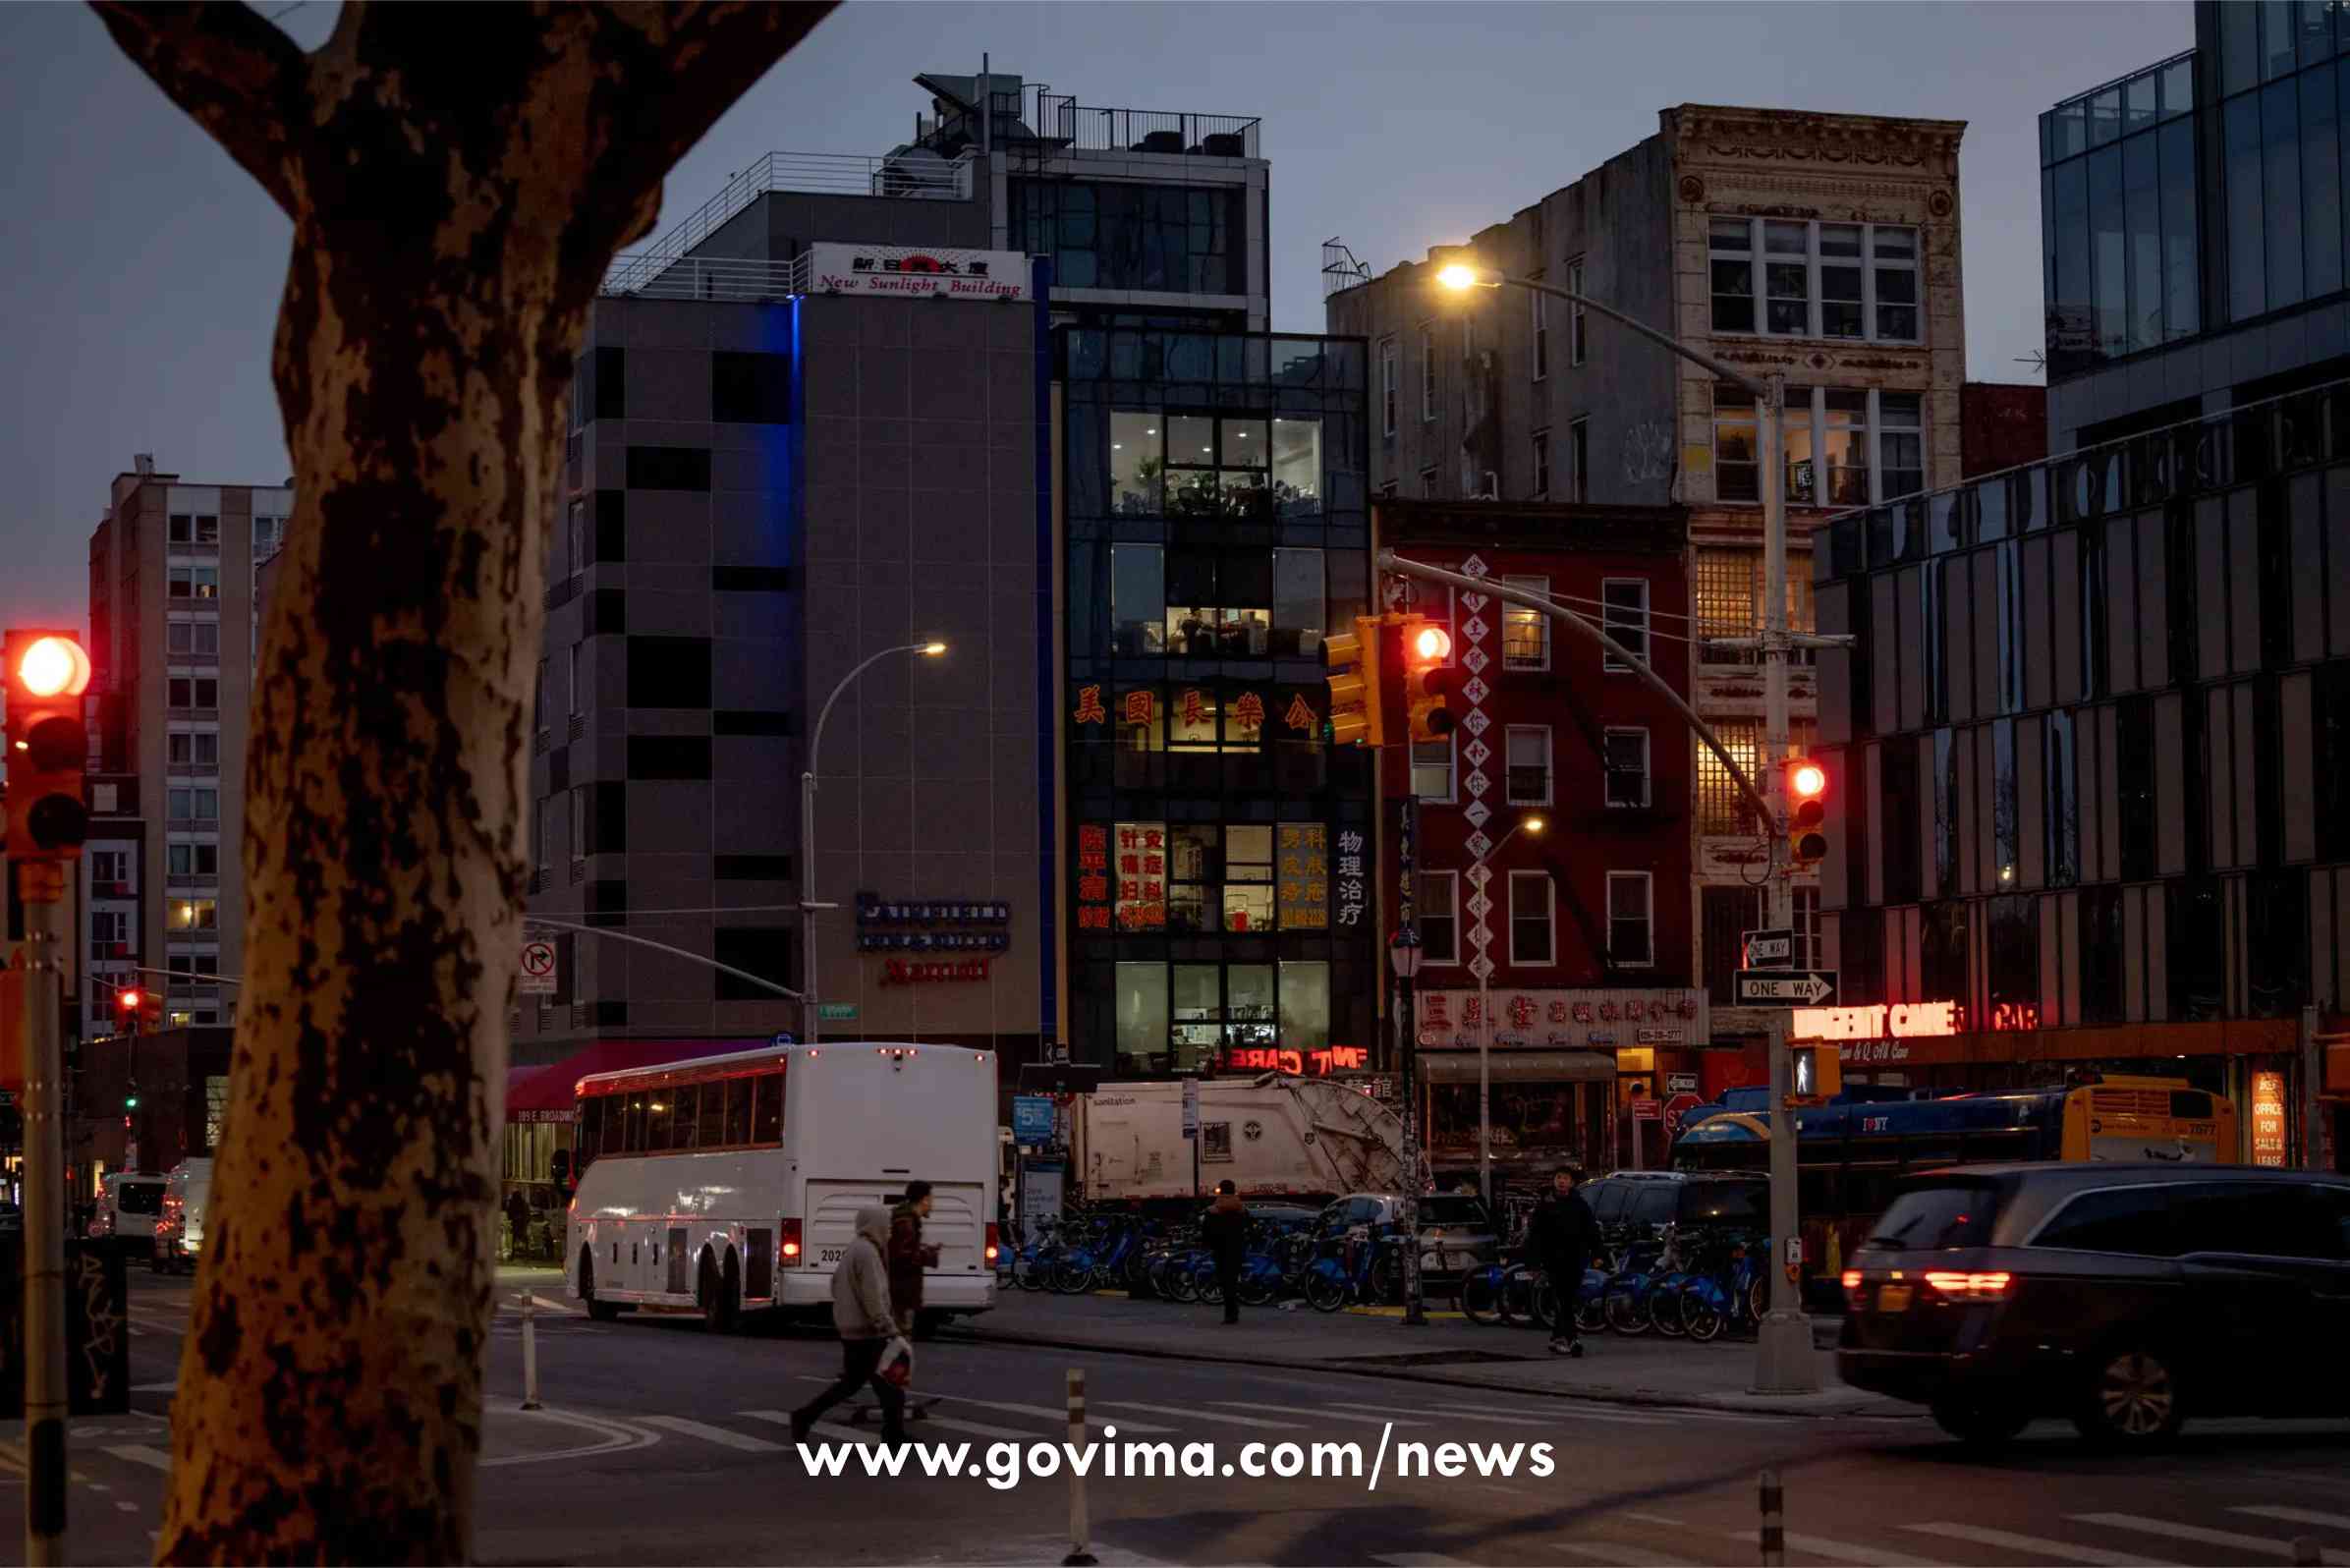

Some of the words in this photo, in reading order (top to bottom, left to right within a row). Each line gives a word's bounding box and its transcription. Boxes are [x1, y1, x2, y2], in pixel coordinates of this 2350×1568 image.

[819, 274, 859, 289] New
[869, 276, 939, 294] Sunlight
[950, 280, 1022, 298] Building
[1337, 830, 1366, 926] 物理治疗
[1768, 941, 1786, 957] WAY
[1750, 981, 1778, 996] ONE
[1793, 981, 1822, 996] WAY
[1093, 1097, 1137, 1107] sanitation
[2254, 1102, 2282, 1116] OFFICE
[2260, 1120, 2278, 1133] FOR
